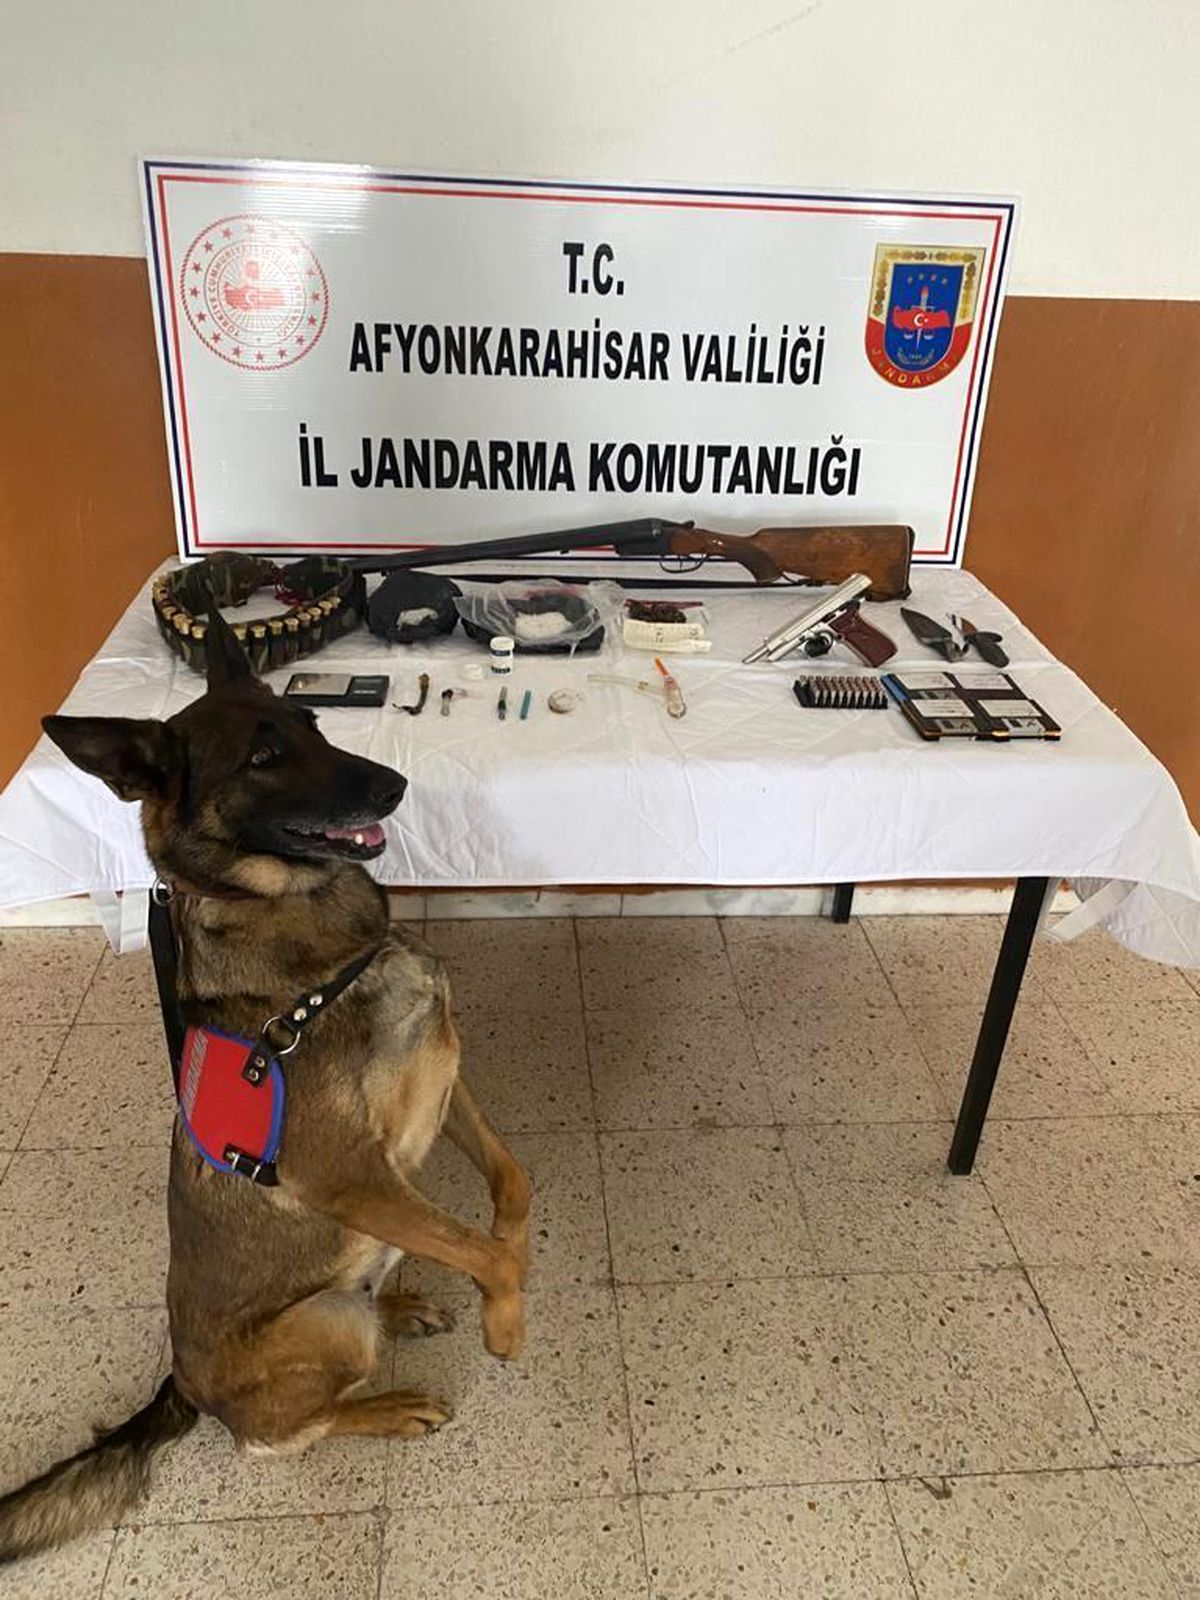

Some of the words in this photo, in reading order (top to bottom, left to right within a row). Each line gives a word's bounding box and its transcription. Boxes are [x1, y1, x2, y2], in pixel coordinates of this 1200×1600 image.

[563, 242, 624, 296] T.C.
[349, 318, 670, 381] AFYONKARAHİSAR
[682, 323, 825, 385] VALİLİĞİ
[872, 347, 957, 385] JNDARM
[299, 422, 339, 488] İL
[350, 437, 576, 492] JANDARMA
[588, 434, 861, 496] KOMUTANLIĞI
